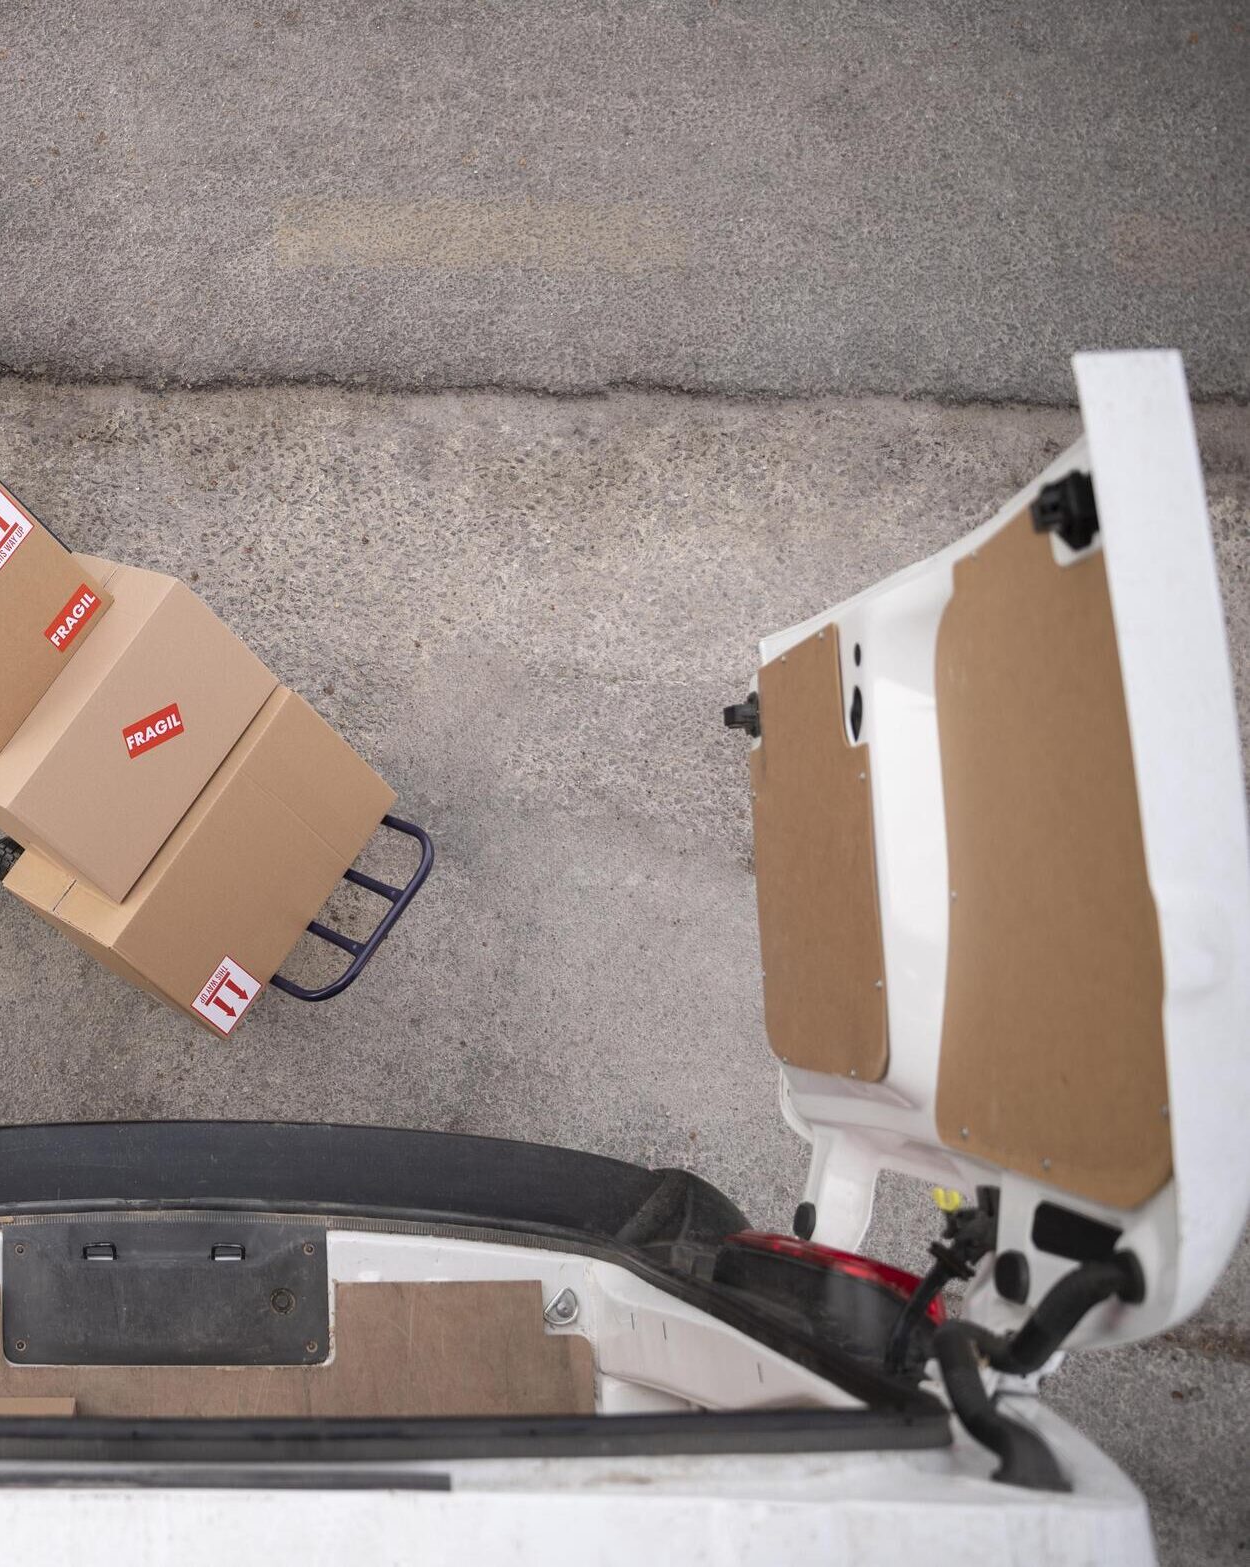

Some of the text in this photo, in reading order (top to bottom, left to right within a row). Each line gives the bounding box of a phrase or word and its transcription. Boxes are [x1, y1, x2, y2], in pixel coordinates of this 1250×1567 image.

[3, 534, 18, 552] WAY
[14, 525, 25, 538] UP
[50, 593, 96, 647] FRAGIL
[126, 713, 181, 751] FRAGIL
[199, 964, 229, 1004] THIS WAY UP
